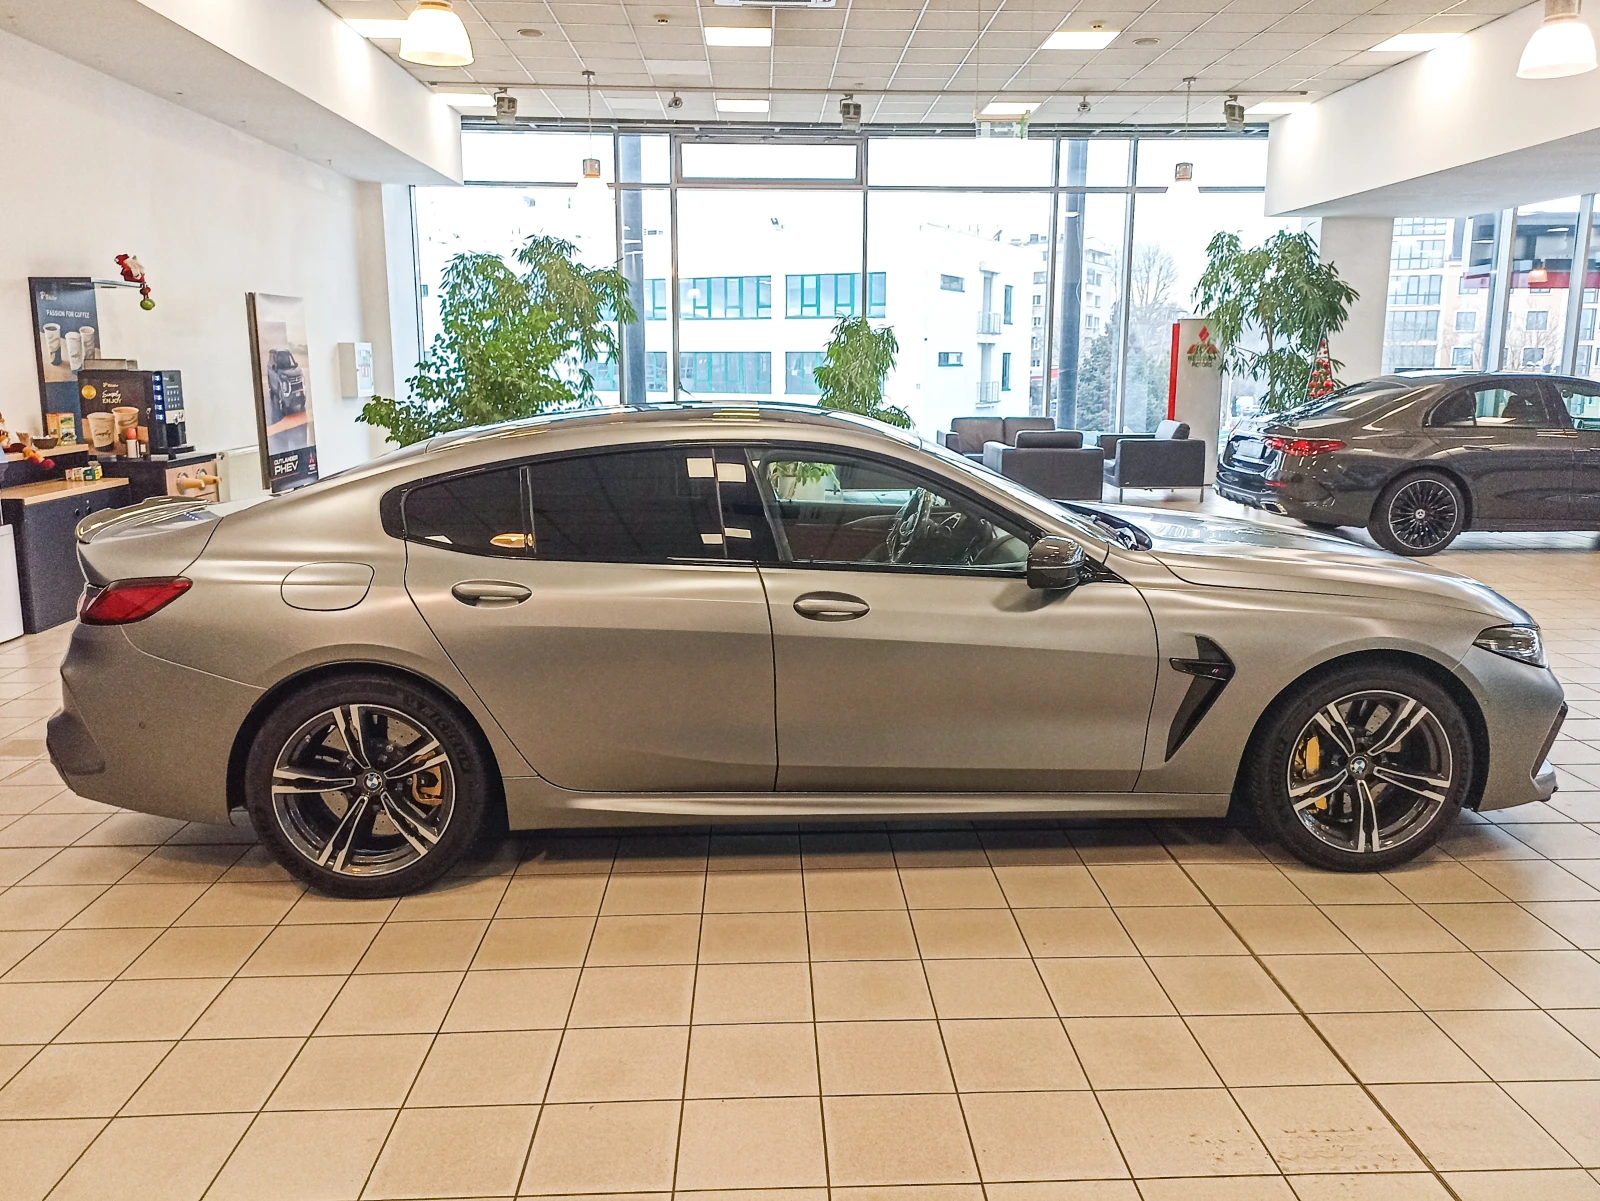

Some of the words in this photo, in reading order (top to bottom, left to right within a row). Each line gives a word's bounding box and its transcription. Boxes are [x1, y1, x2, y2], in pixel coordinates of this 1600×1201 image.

[46, 309, 65, 317] PASSION
[65, 310, 74, 318] FOR
[74, 311, 90, 319] COFFEE
[274, 455, 298, 465] OUTLANDER
[274, 461, 298, 476] PHEV
